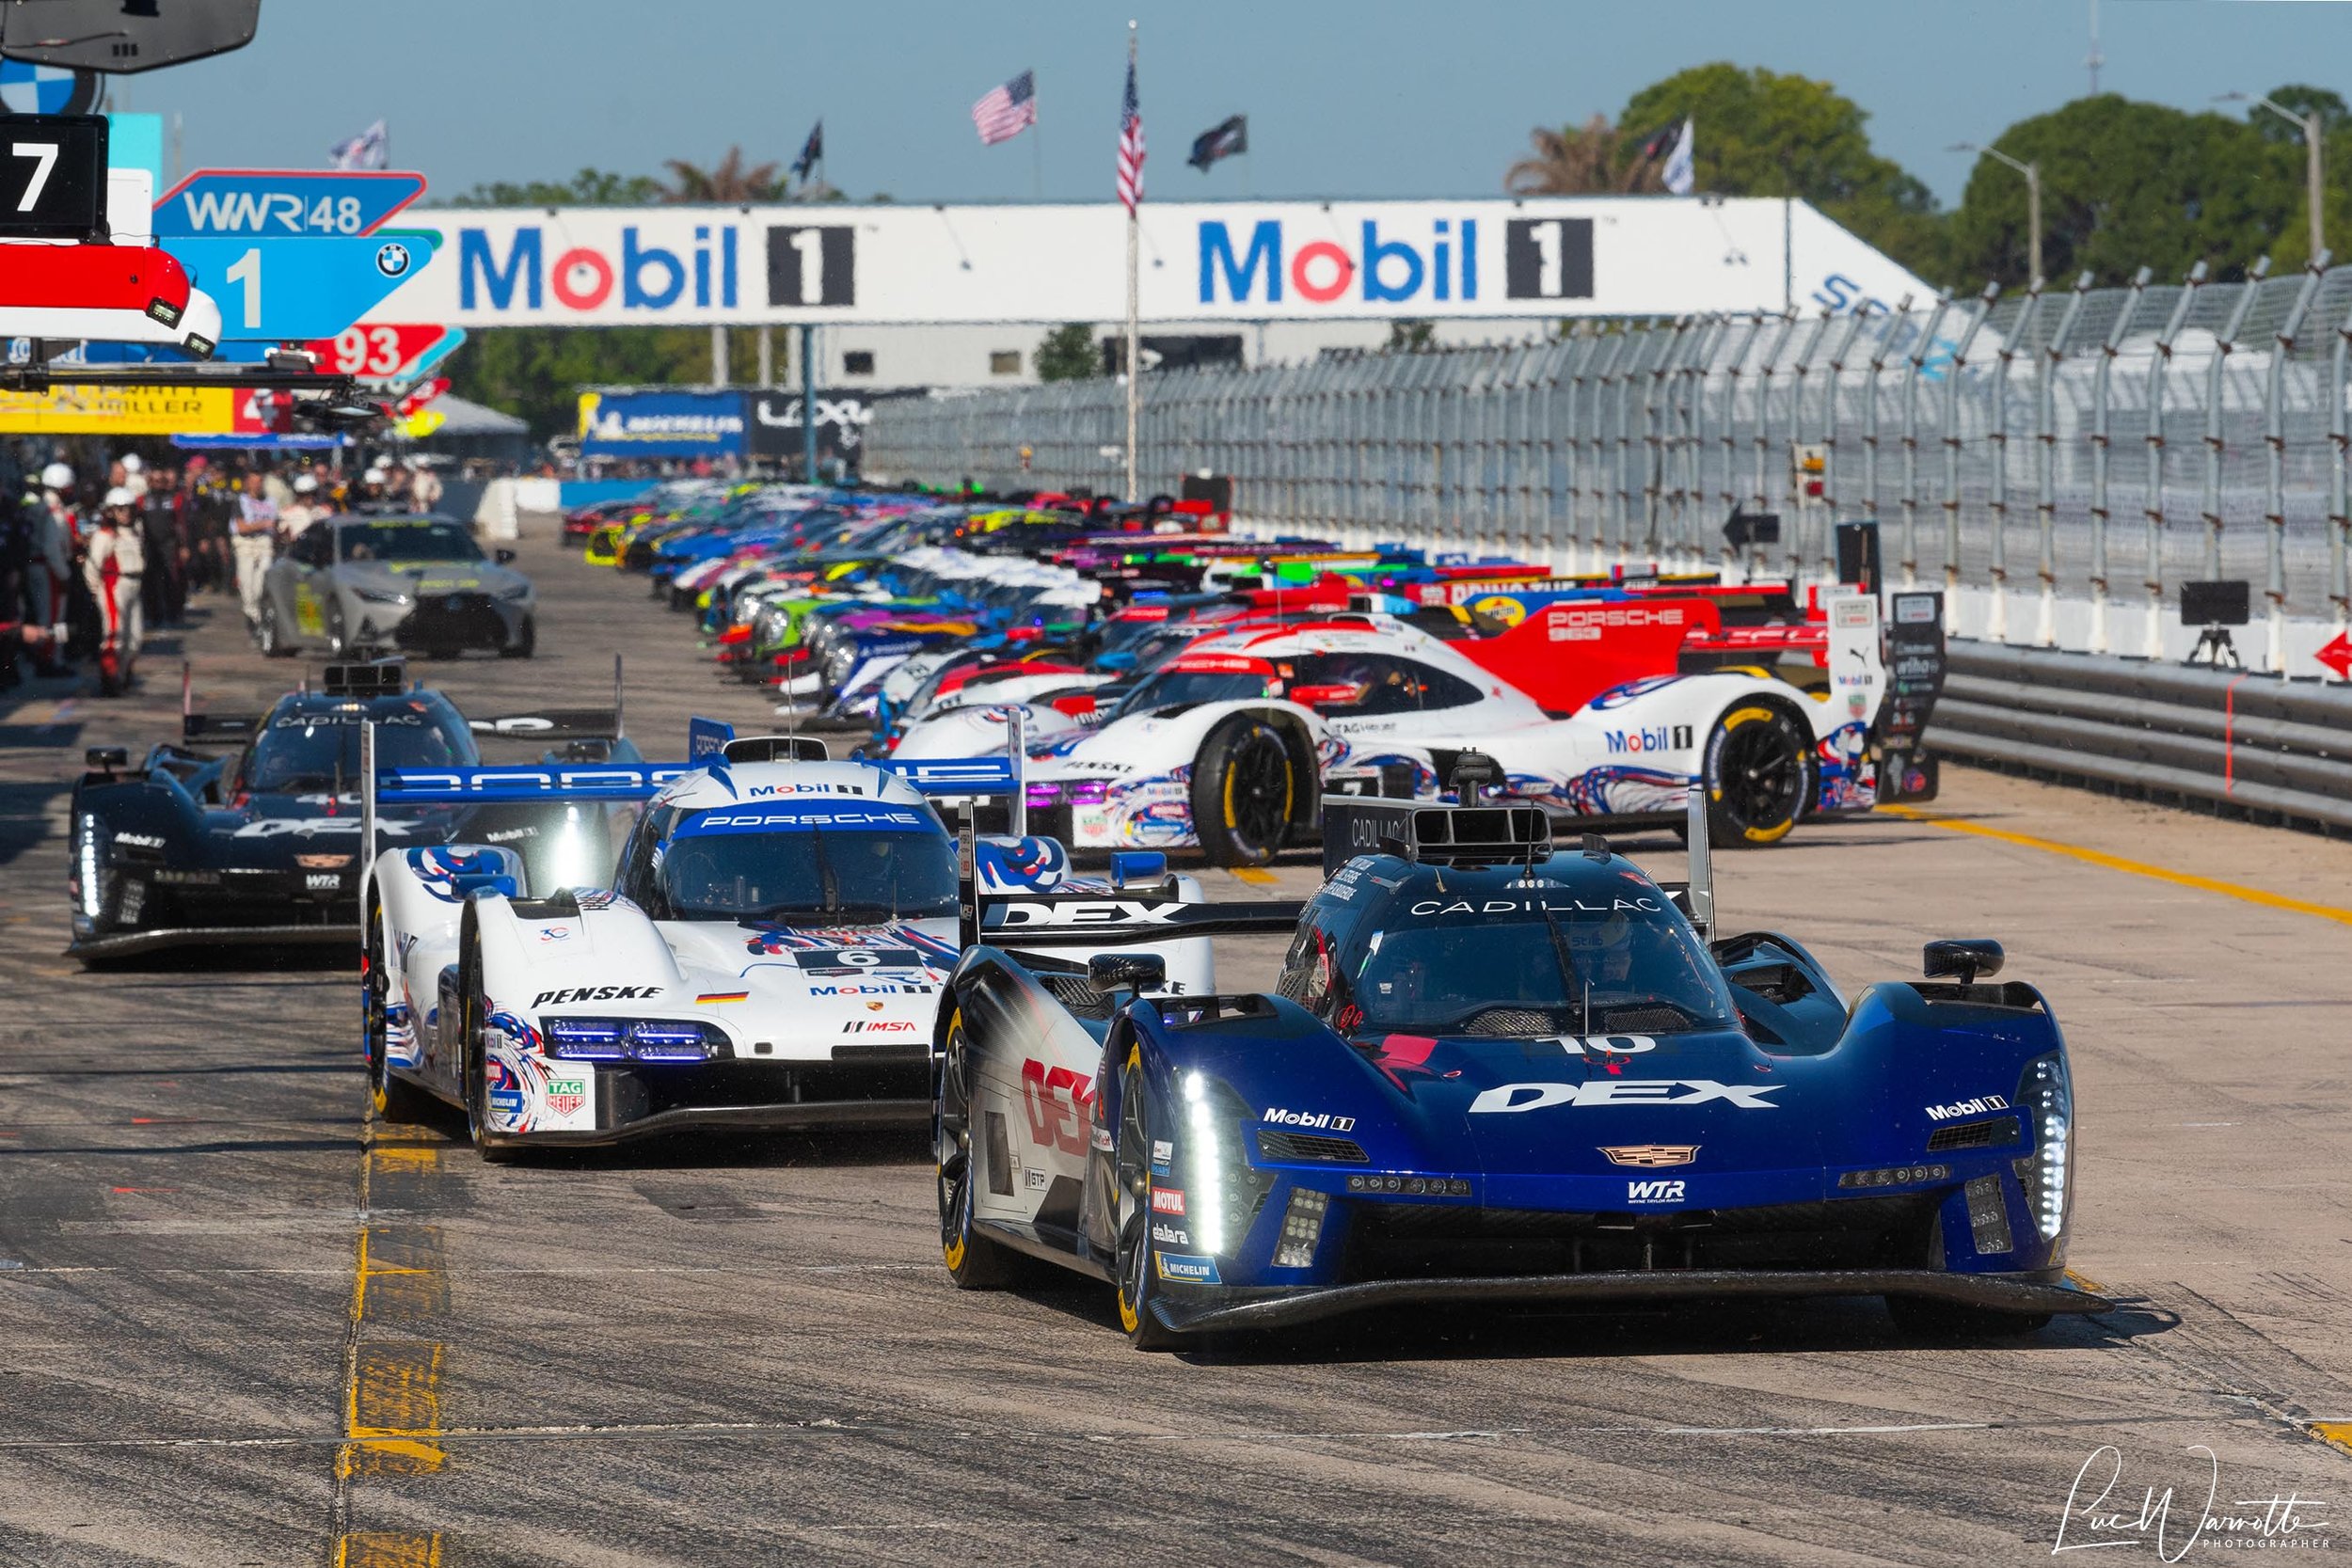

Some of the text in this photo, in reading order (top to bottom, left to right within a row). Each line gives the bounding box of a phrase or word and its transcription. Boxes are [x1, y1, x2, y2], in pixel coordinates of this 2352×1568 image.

[12, 143, 58, 212] 7
[310, 196, 361, 233] 48
[458, 225, 738, 310] Mobil
[1198, 217, 1477, 304] Mobil
[226, 247, 262, 328] 1
[335, 327, 401, 374] 93
[1547, 610, 1684, 628] PORSCHE
[275, 714, 421, 728] CADILLAC
[1604, 724, 1668, 753] Mobil
[750, 784, 830, 798] Mobil
[700, 813, 921, 829] PORSCHE
[1352, 818, 1400, 847] CADILLAC
[306, 875, 341, 889] WTR
[981, 900, 1188, 927] DEX
[1410, 898, 1662, 916] CADILLAC
[836, 950, 882, 967] 6
[530, 986, 665, 1010] PENSKE
[810, 985, 898, 996] Mobil
[866, 1022, 916, 1032] IMSA
[1534, 1035, 1657, 1054] 10
[549, 1083, 581, 1094] TAG
[1468, 1079, 1788, 1114] DEX
[548, 1095, 583, 1117] HEUER
[1925, 1098, 1988, 1121] Mobil
[1263, 1107, 1331, 1129] Mobil
[1628, 1180, 1686, 1199] WTR
[1153, 1190, 1184, 1212] MOTUL
[1152, 1223, 1189, 1244] dallara
[1169, 1262, 1211, 1276] MICHELIN
